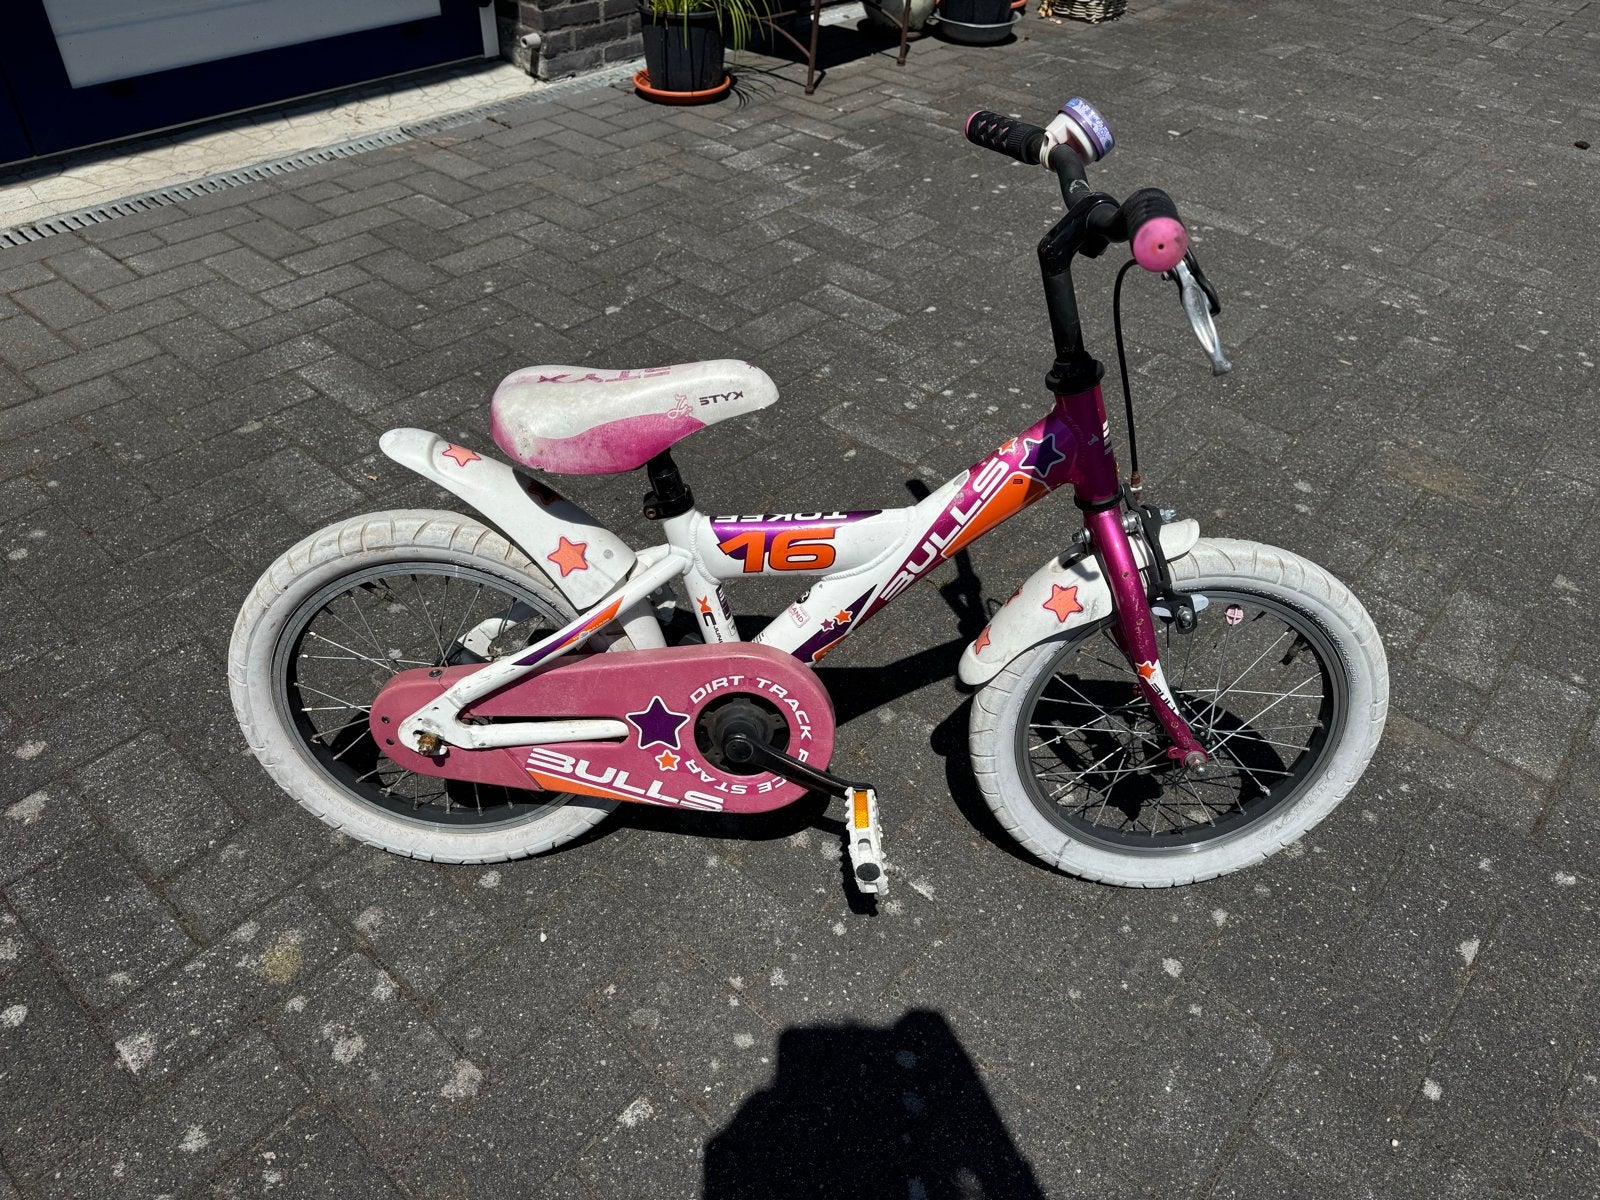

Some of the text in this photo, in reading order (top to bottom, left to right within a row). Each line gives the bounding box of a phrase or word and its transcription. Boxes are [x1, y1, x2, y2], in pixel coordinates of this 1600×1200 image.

[699, 390, 744, 406] STYX
[716, 527, 836, 573] 16
[880, 457, 1010, 601] BULLS
[685, 675, 812, 794] DIRT TRACK RCE STAR
[526, 747, 724, 813] BULLS
